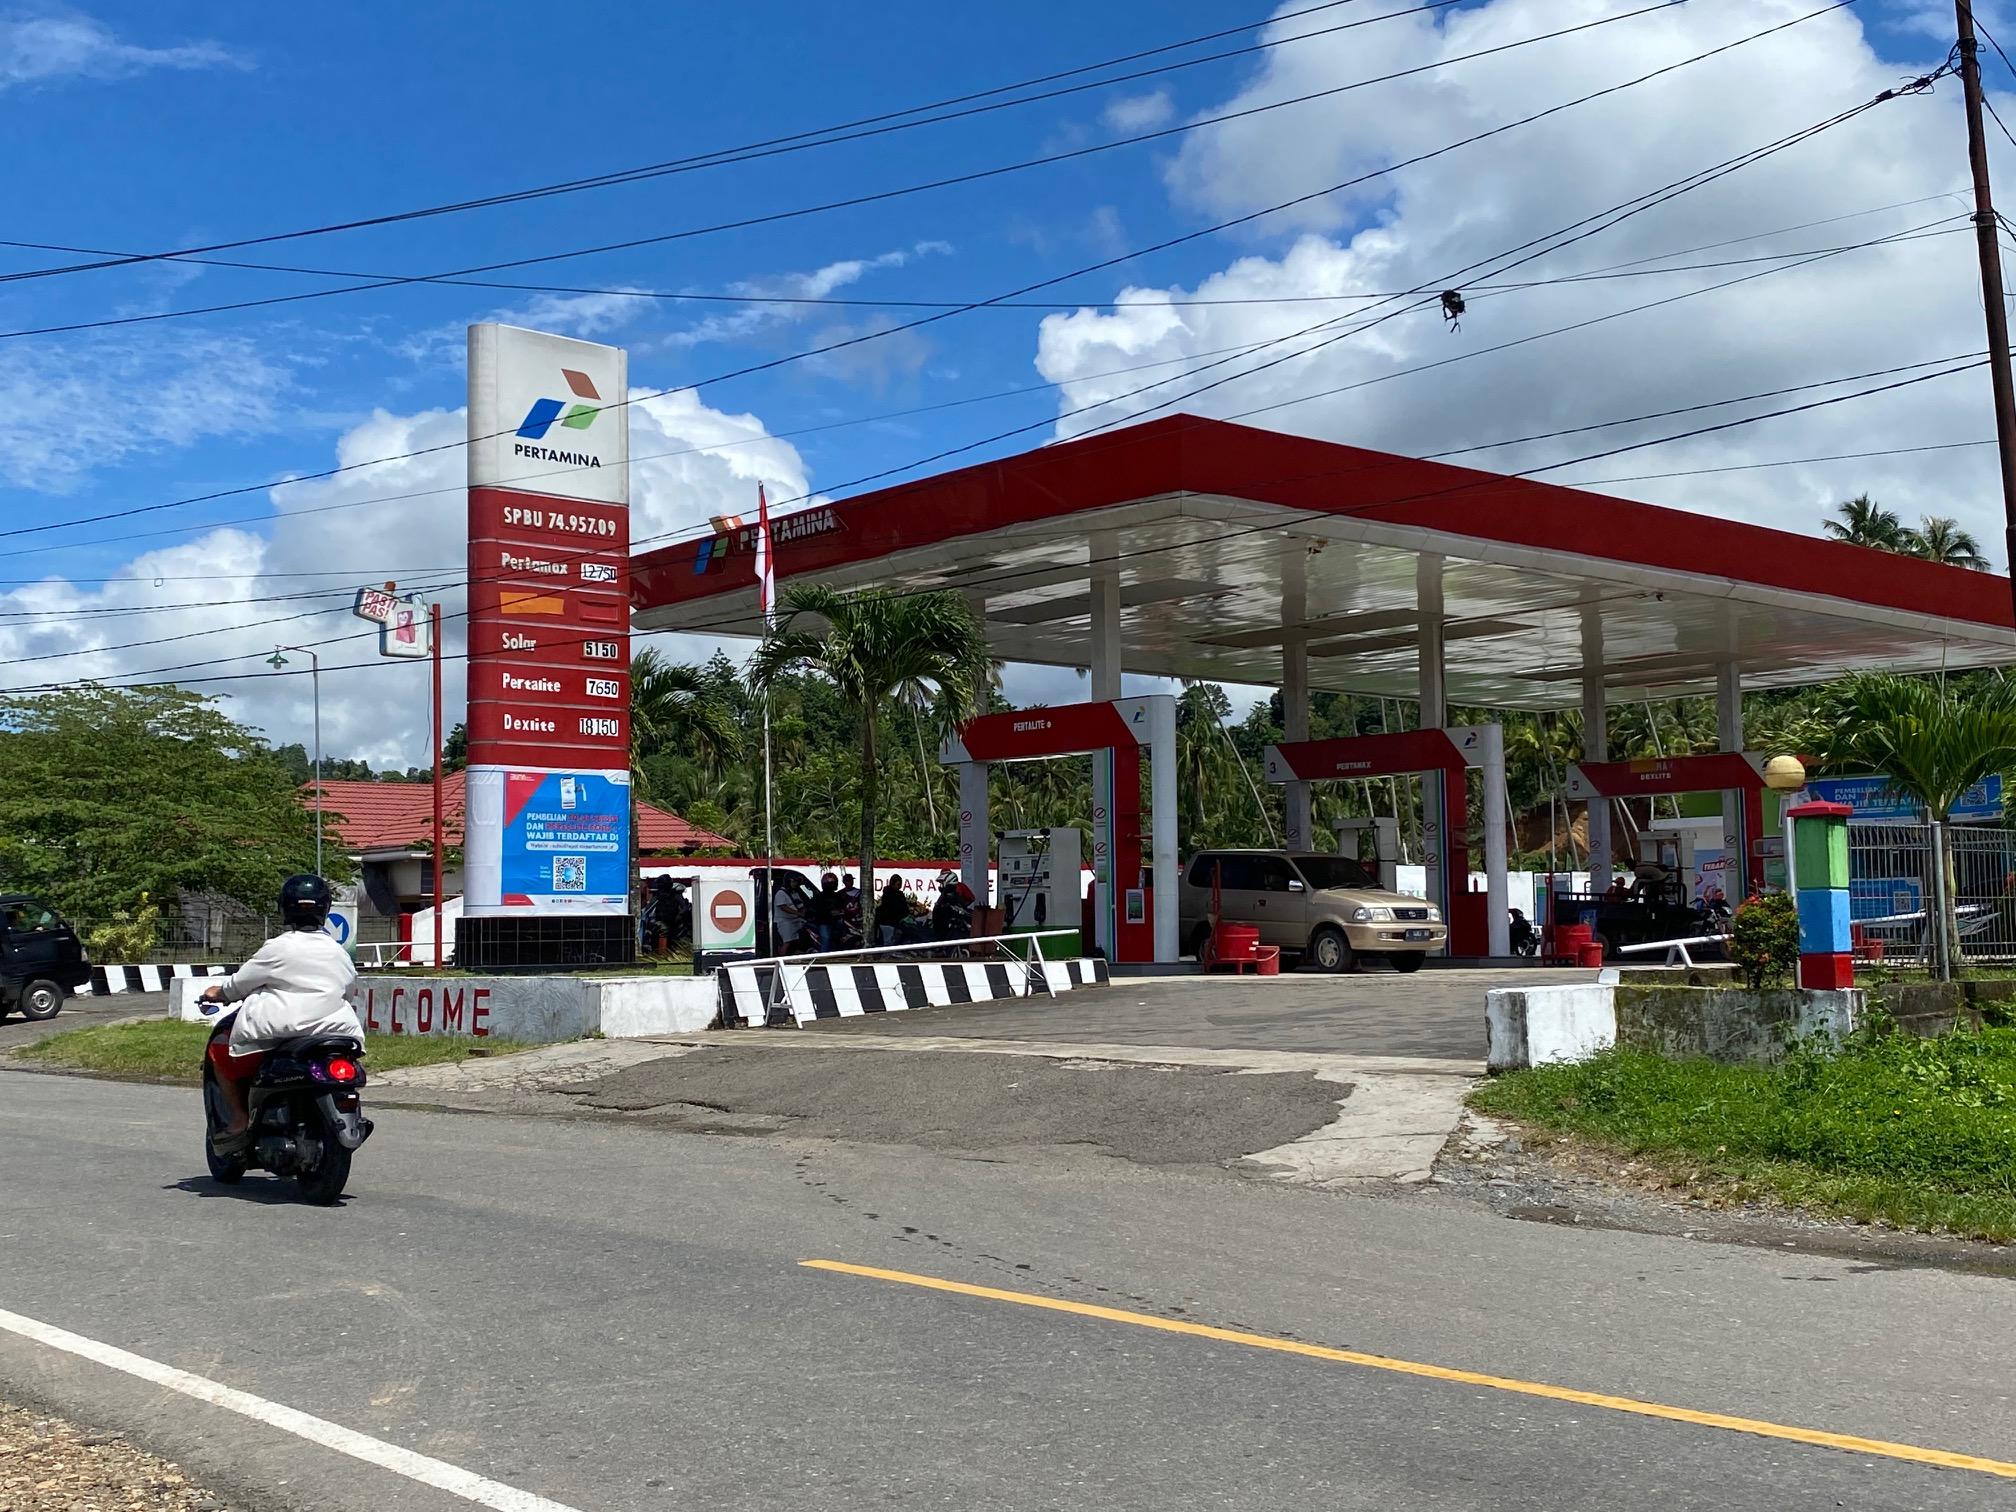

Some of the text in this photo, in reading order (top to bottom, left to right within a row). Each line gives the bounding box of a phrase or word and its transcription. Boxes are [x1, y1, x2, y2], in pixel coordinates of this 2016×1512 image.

[514, 443, 601, 468] PERTAMINA
[503, 506, 616, 537] SPBU 74.957.09
[739, 508, 835, 551] PETAMINA
[501, 552, 617, 581] Pertamax 12750
[502, 632, 617, 658] Solar 5150
[502, 672, 618, 696] Pertalite 7650
[504, 713, 618, 735] Dexlite 18150
[1013, 719, 1045, 732] PERTALITE
[1269, 761, 1277, 774] 3
[1571, 780, 1579, 792] 5
[526, 812, 567, 821] PEMBELIAN
[526, 822, 544, 831] DAN
[526, 832, 619, 842] WAJIB TERDAFTAR DI
